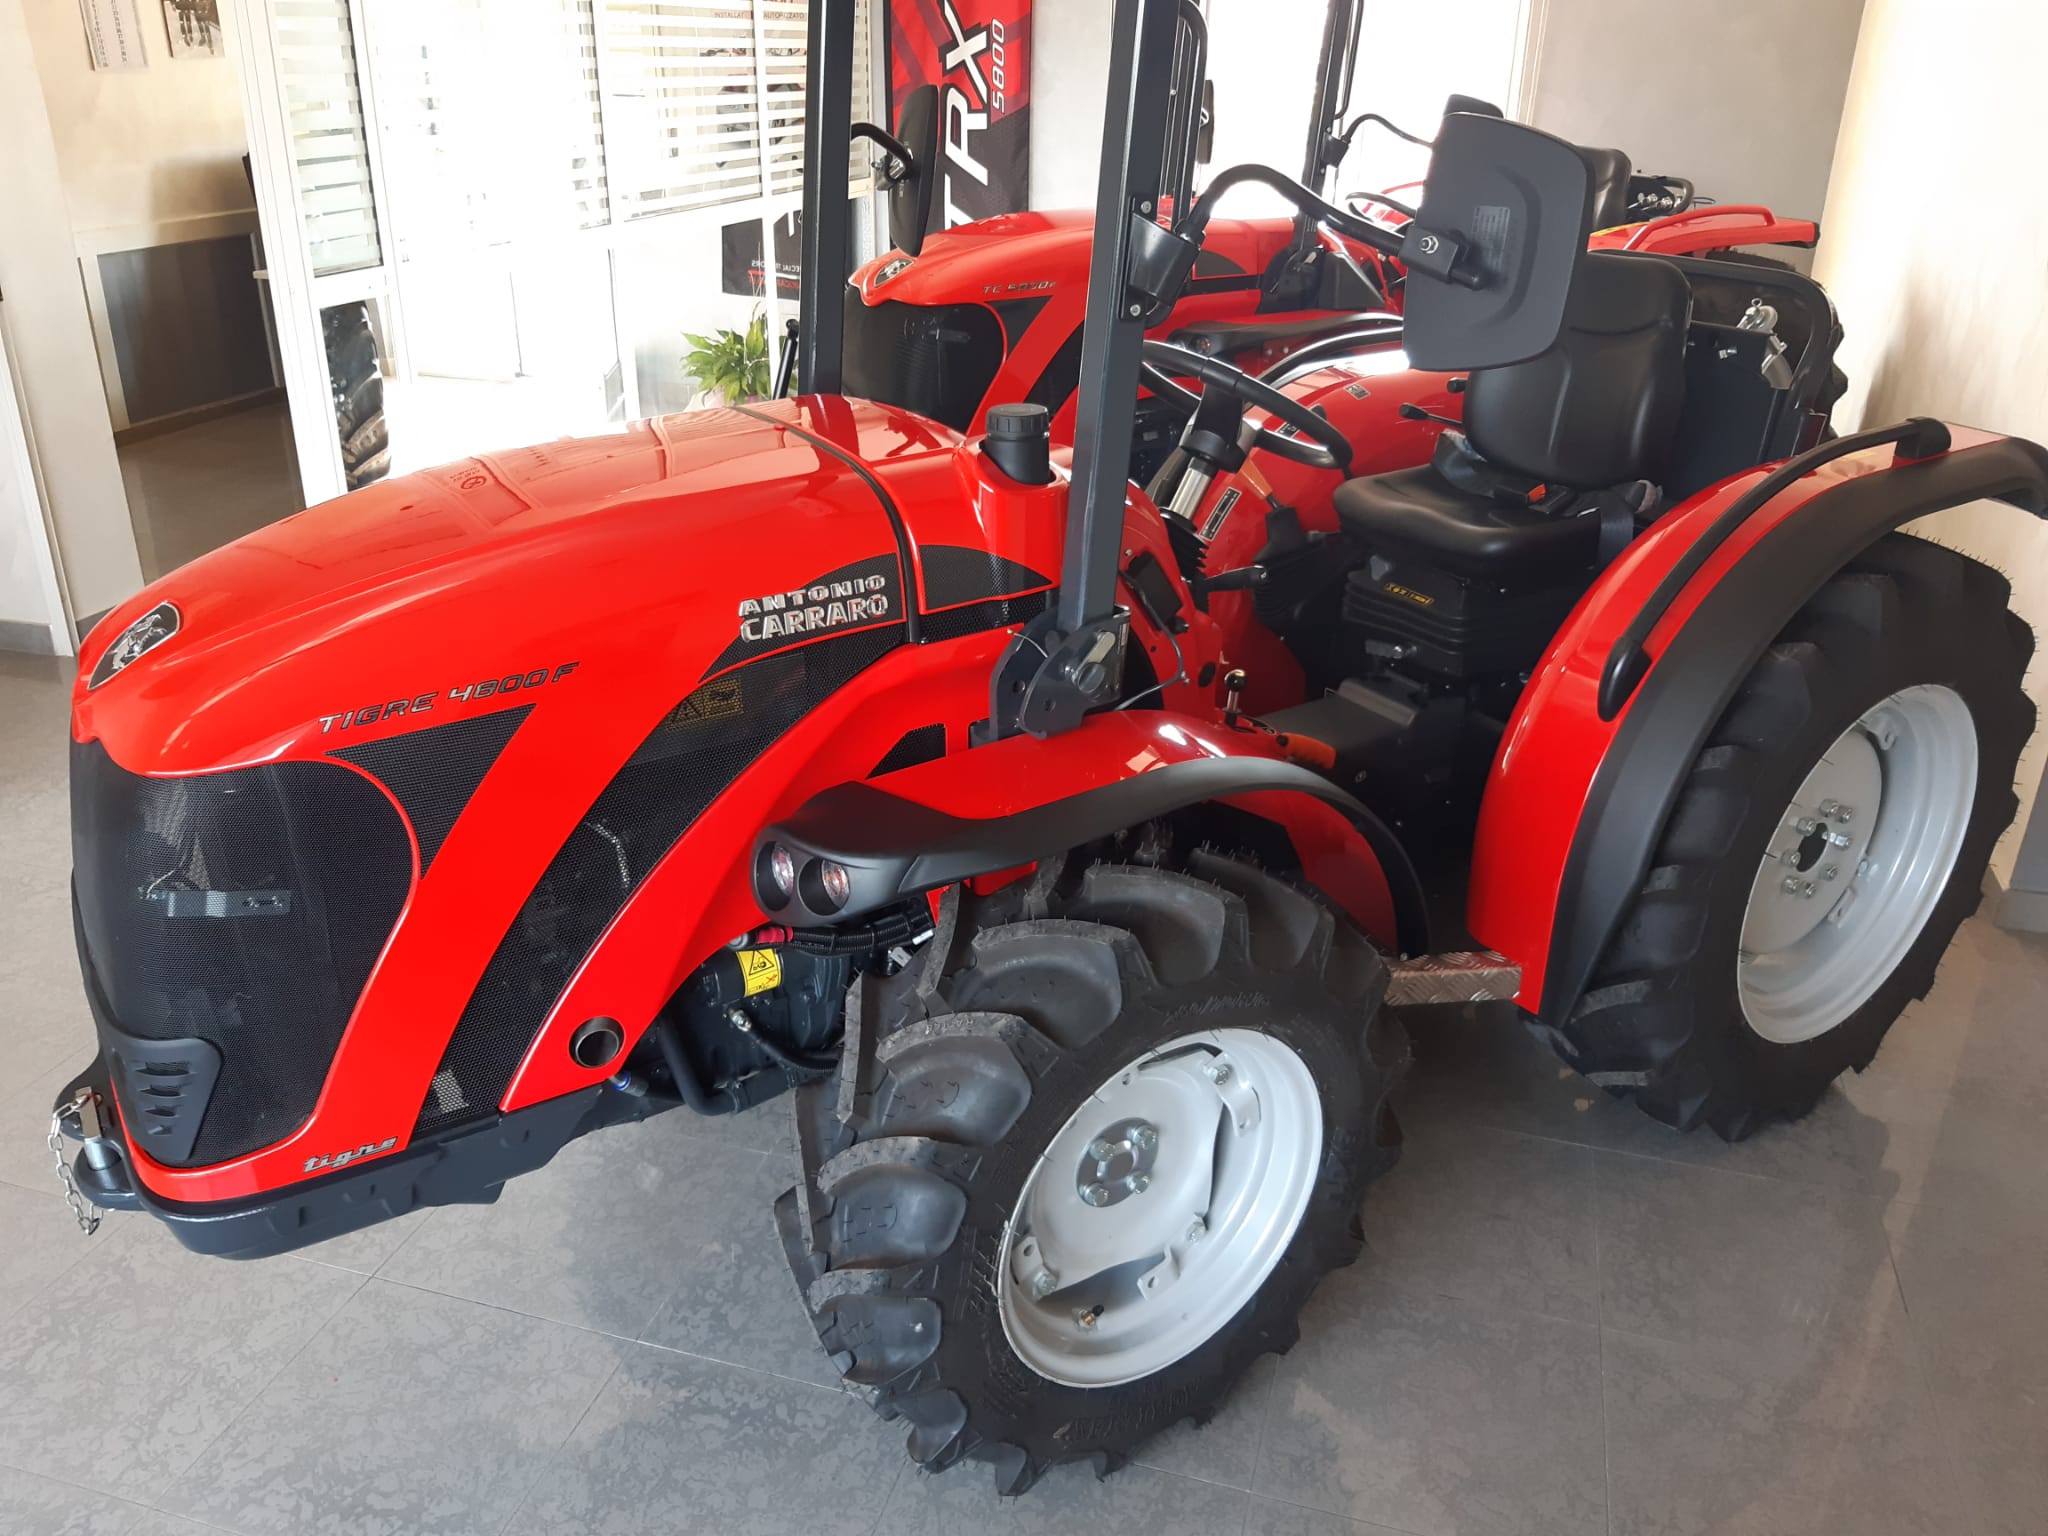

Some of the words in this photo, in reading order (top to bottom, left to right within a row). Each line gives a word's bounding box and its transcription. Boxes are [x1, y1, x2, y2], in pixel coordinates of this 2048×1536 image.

[992, 19, 1005, 113] 5800
[983, 285, 1004, 295] TC
[739, 575, 885, 617] ANTONIO
[740, 593, 888, 642] CARRARO
[319, 692, 439, 734] TIGRE
